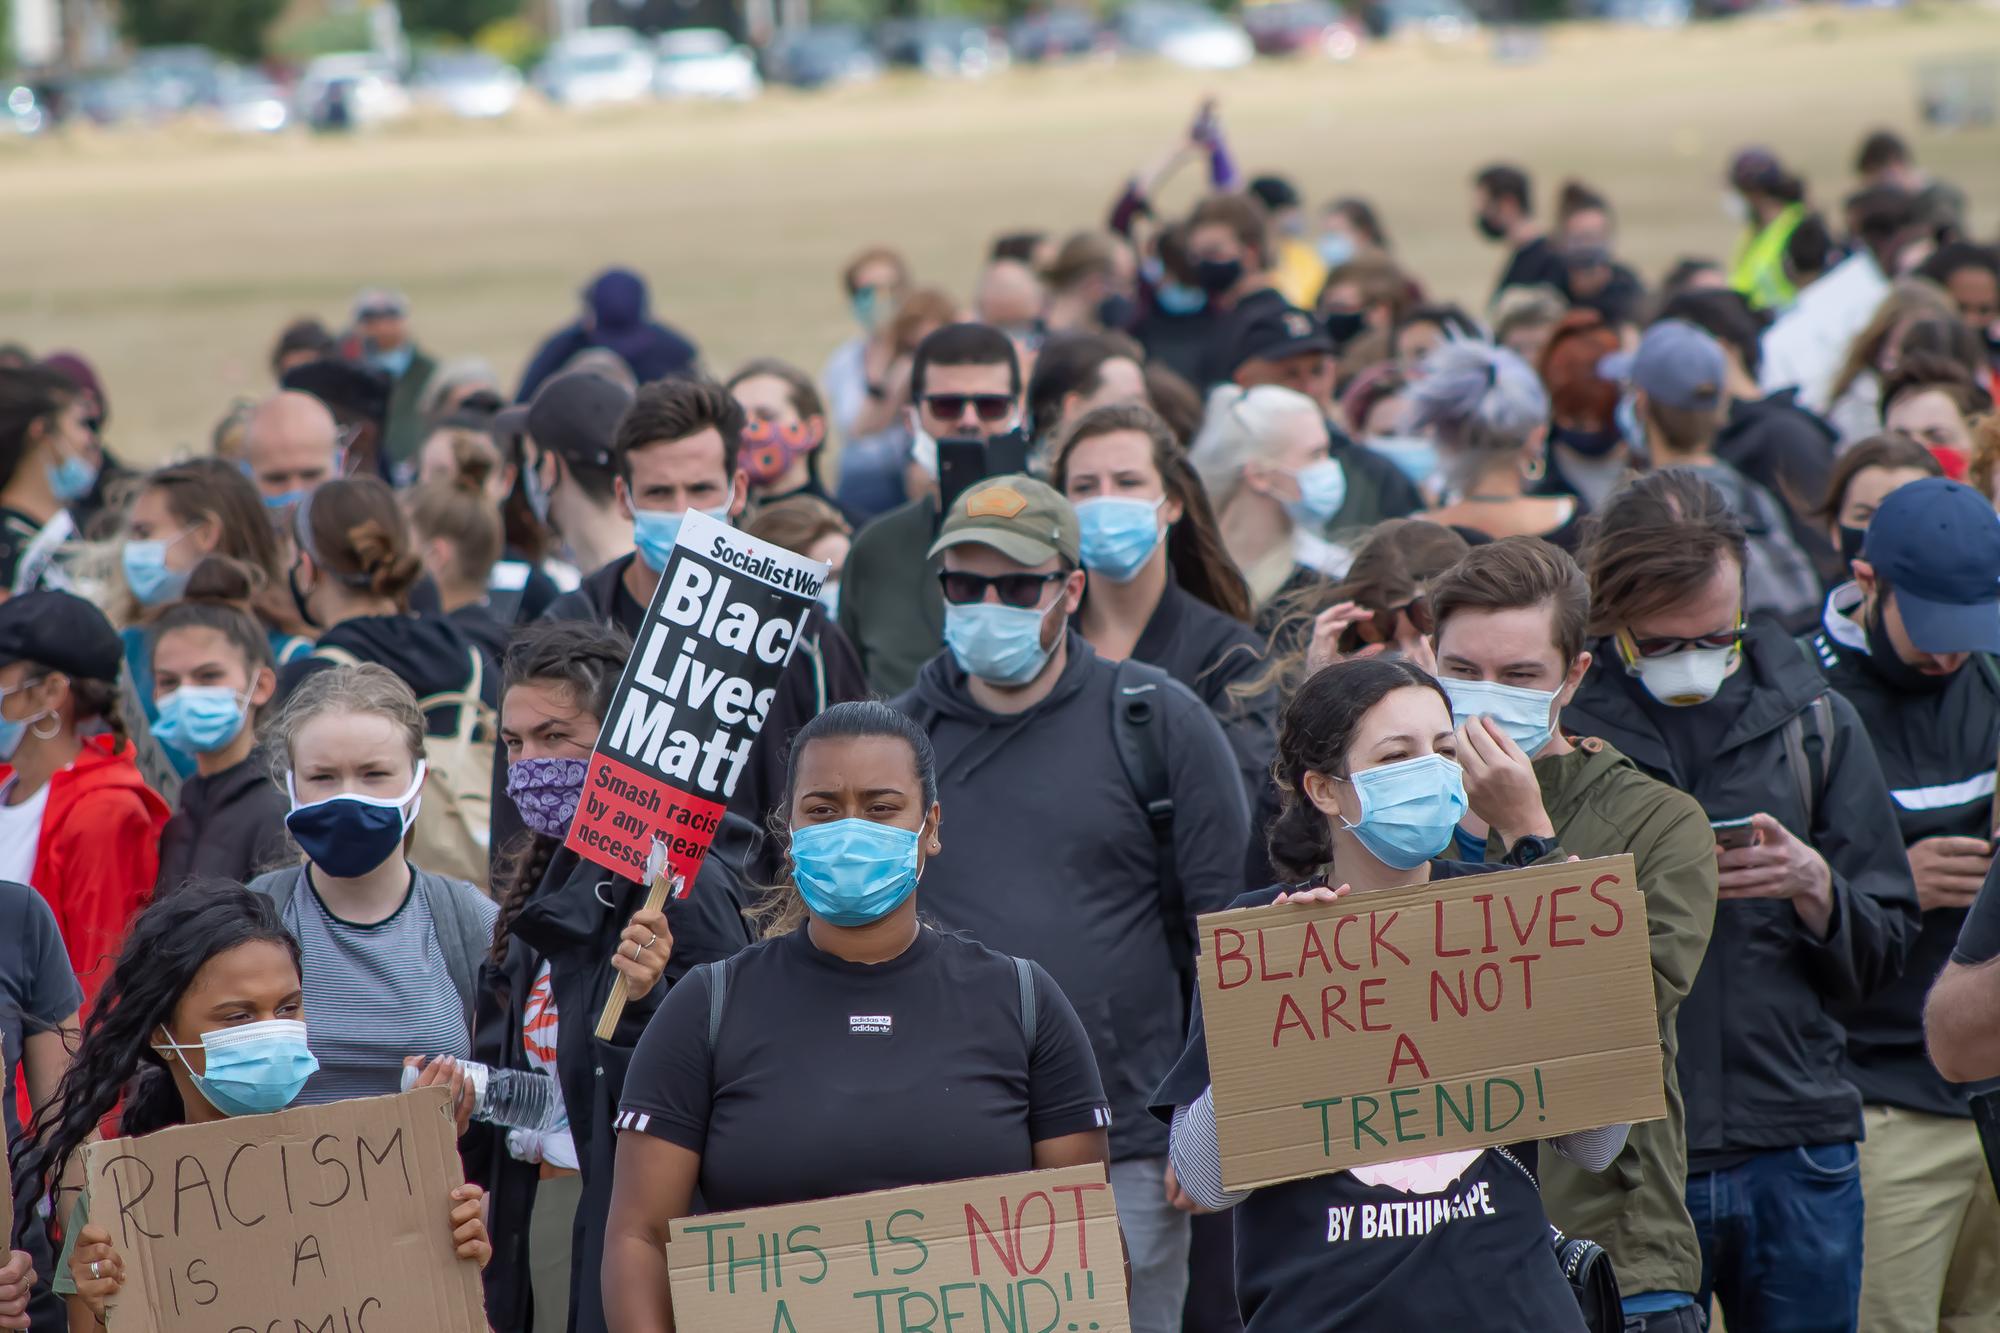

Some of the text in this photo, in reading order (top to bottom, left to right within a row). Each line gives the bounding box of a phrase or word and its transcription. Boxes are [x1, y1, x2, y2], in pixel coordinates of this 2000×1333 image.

[710, 536, 794, 588] Socialist
[635, 624, 776, 733] Lives
[586, 791, 610, 822] by
[612, 810, 649, 840] any
[594, 764, 661, 814] Smash
[1214, 873, 1625, 990] BLACK LIVES
[1272, 954, 1541, 1048] ARE NOT
[1387, 1032, 1430, 1084] A
[1302, 1067, 1546, 1157] TREND!
[101, 1127, 413, 1249] RACISM
[1327, 1205, 1355, 1242] BY
[169, 1259, 219, 1316] IS
[292, 1235, 327, 1286] A
[683, 1182, 1107, 1294] THIS IS NOT
